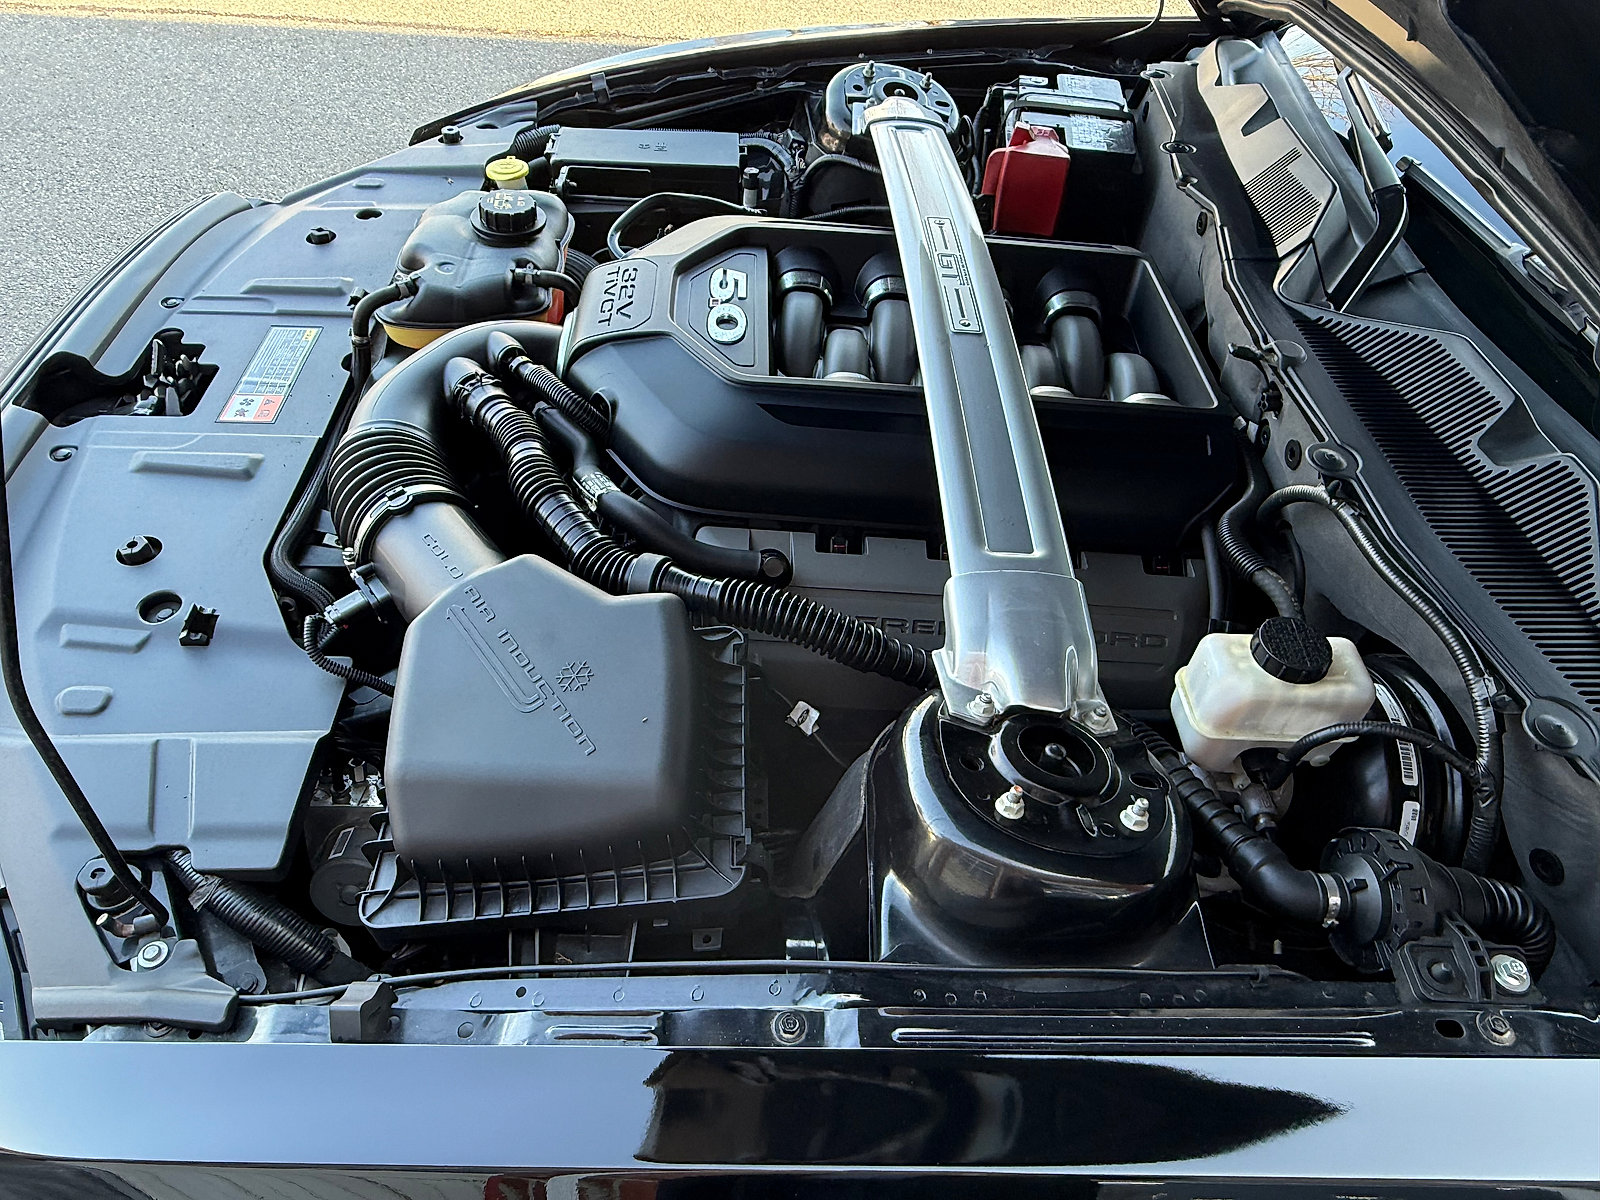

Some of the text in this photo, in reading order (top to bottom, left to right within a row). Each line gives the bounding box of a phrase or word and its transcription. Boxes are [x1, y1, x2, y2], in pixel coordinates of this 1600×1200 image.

[615, 266, 639, 319] 32V
[421, 533, 464, 580] COLD
[497, 628, 597, 757] INDUCTION
